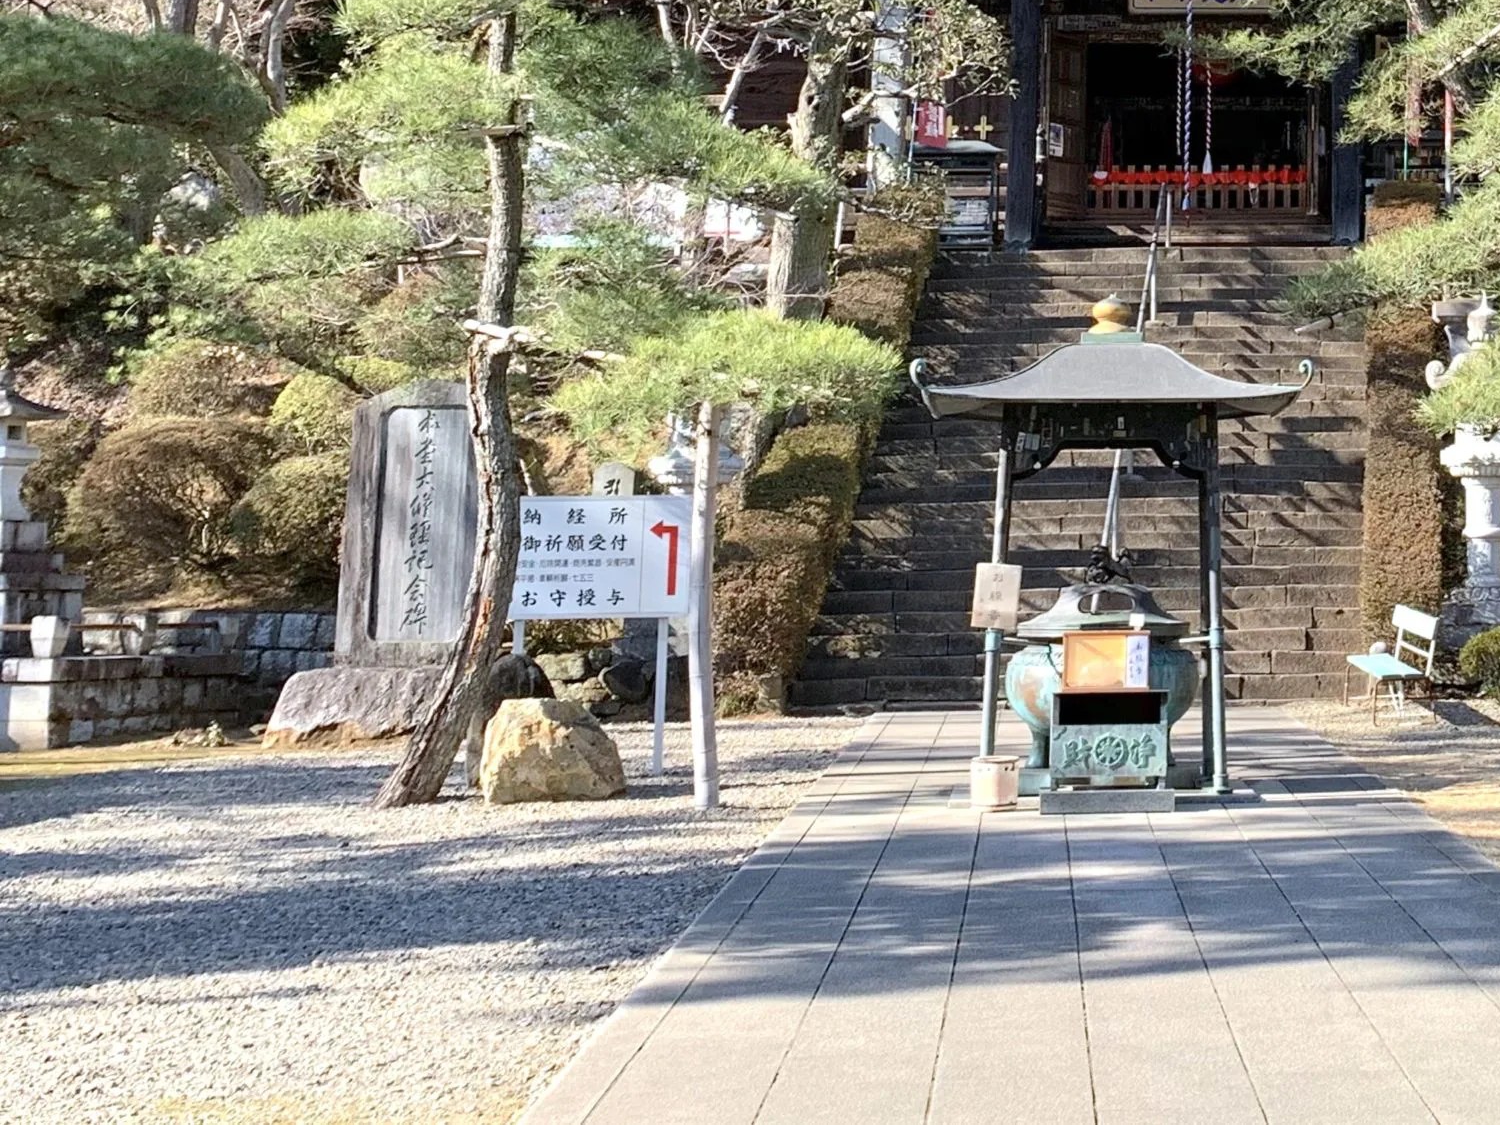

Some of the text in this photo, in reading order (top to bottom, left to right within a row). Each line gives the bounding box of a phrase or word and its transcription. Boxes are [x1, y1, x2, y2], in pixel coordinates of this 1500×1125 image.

[523, 507, 629, 525] 納経所
[522, 534, 628, 553] 御祈願受付
[521, 588, 625, 608] お守授与
